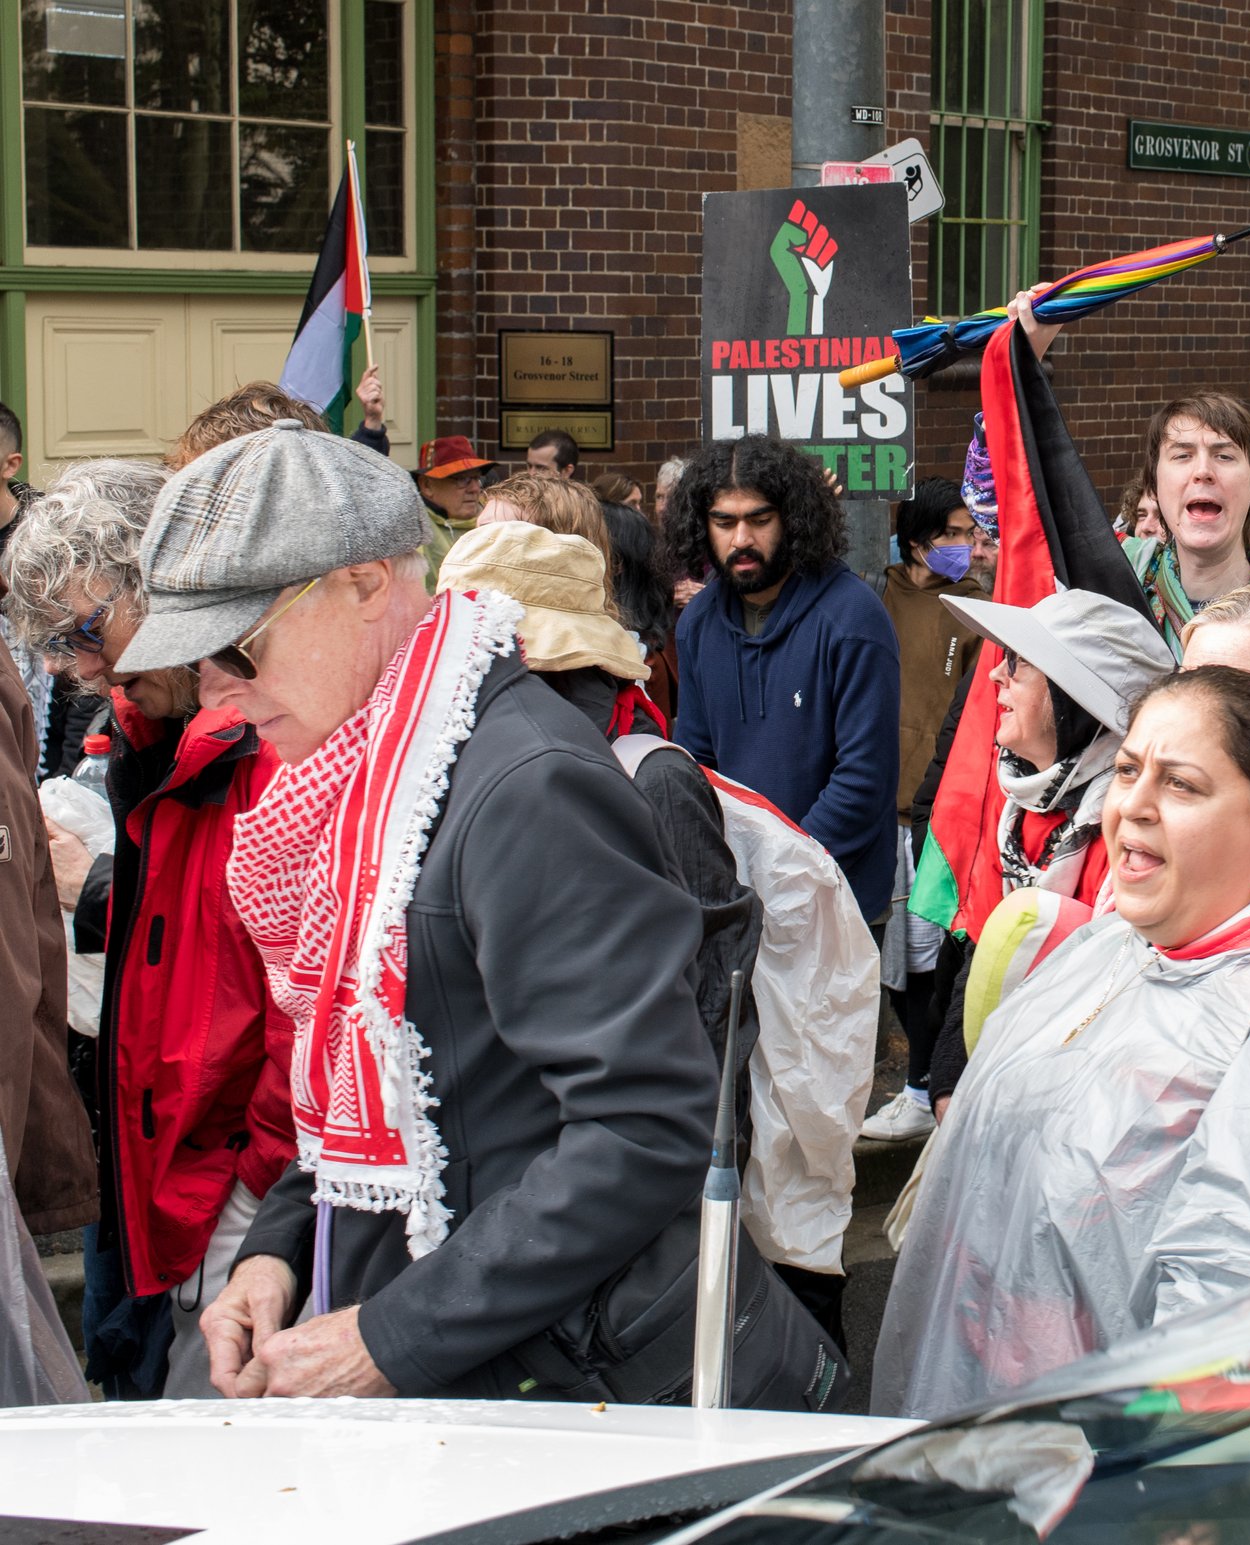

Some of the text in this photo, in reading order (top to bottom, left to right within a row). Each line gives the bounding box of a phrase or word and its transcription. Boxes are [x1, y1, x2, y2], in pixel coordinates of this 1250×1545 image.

[1135, 134, 1244, 162] GROSVENOR ST
[513, 370, 599, 381] Grosvenor Street
[540, 356, 551, 366] 16
[562, 356, 573, 366] 18
[712, 373, 907, 440] LIVES
[796, 444, 908, 491] TER
[945, 637, 957, 676] NANA JUDY
